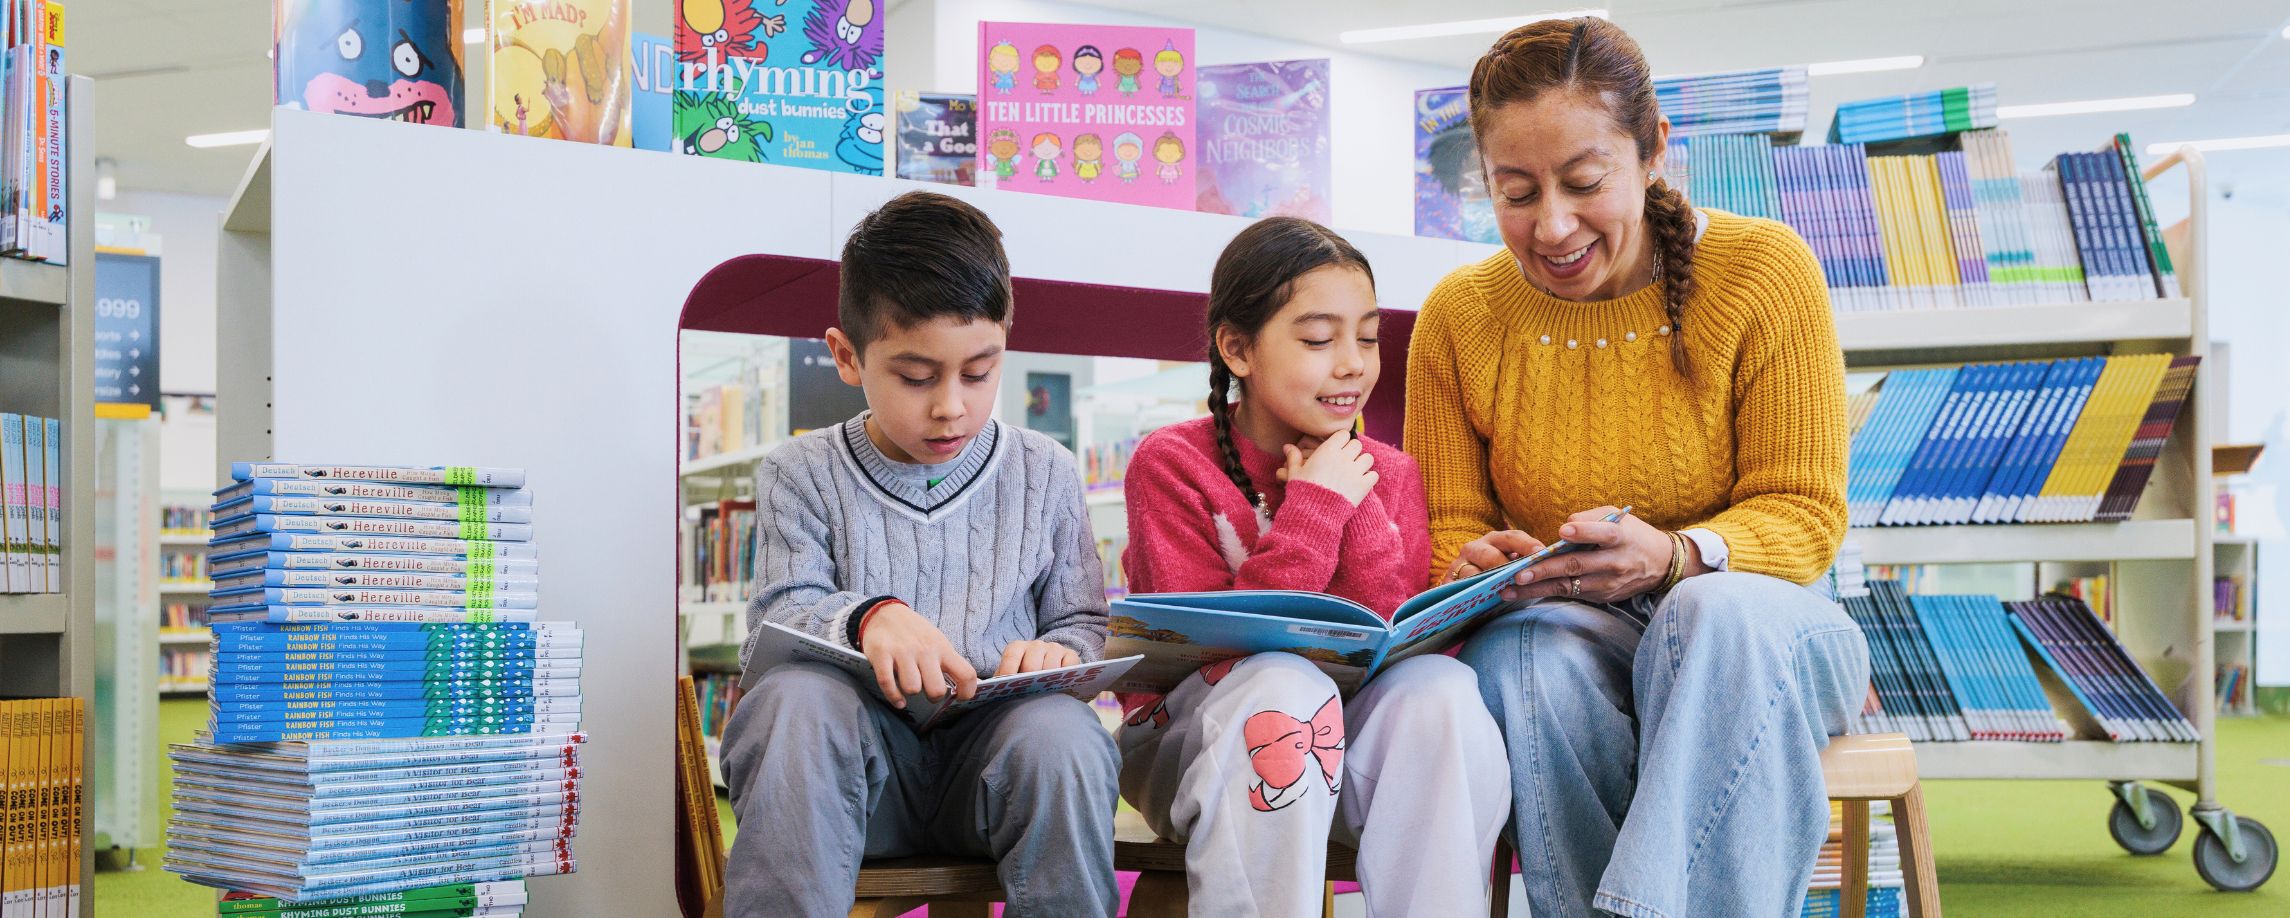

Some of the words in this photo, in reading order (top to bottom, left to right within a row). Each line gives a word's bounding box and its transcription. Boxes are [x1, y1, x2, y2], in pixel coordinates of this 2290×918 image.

[540, 2, 587, 28] MAD?
[678, 46, 877, 113] rhyming
[738, 100, 777, 116] dust
[781, 102, 847, 119] bunnies
[949, 100, 966, 112] Mo
[987, 101, 1020, 122] TEN
[1025, 102, 1080, 123] LITTLE
[1084, 103, 1186, 126] PRINCESSES
[925, 119, 969, 137] That
[1223, 114, 1291, 136] COSMIC
[50, 109, 59, 156] 5-MINUTE
[783, 131, 799, 146] by
[794, 139, 816, 151] jan
[923, 141, 935, 153] a
[783, 145, 829, 160] thomas
[1206, 138, 1310, 165] NEIGHBORS
[51, 159, 60, 200] STORIES
[333, 468, 397, 479] Hereville
[352, 485, 414, 498] Hereville
[351, 503, 413, 515] Hereville
[354, 521, 415, 533] Hereville
[368, 539, 426, 550] Hereville
[363, 558, 423, 569] Hereville
[362, 575, 422, 586] Hereville
[361, 592, 420, 603] Hereville
[365, 610, 424, 621] Hereville
[413, 768, 443, 777] Visitor
[10, 791, 18, 810] COME
[413, 793, 443, 801] Visitor
[10, 813, 16, 822] ON
[41, 810, 47, 819] ON
[75, 807, 80, 816] ON
[413, 818, 443, 826] Visitor
[461, 814, 481, 822] Bear
[413, 830, 443, 839] Visitor
[408, 867, 438, 876] Visitor
[456, 863, 476, 871] Bear
[359, 892, 403, 902] BUNNIES
[233, 902, 262, 910] thomas
[281, 910, 329, 918] RHYMING
[332, 907, 358, 916] DUST
[361, 904, 406, 913] BUNNIES
